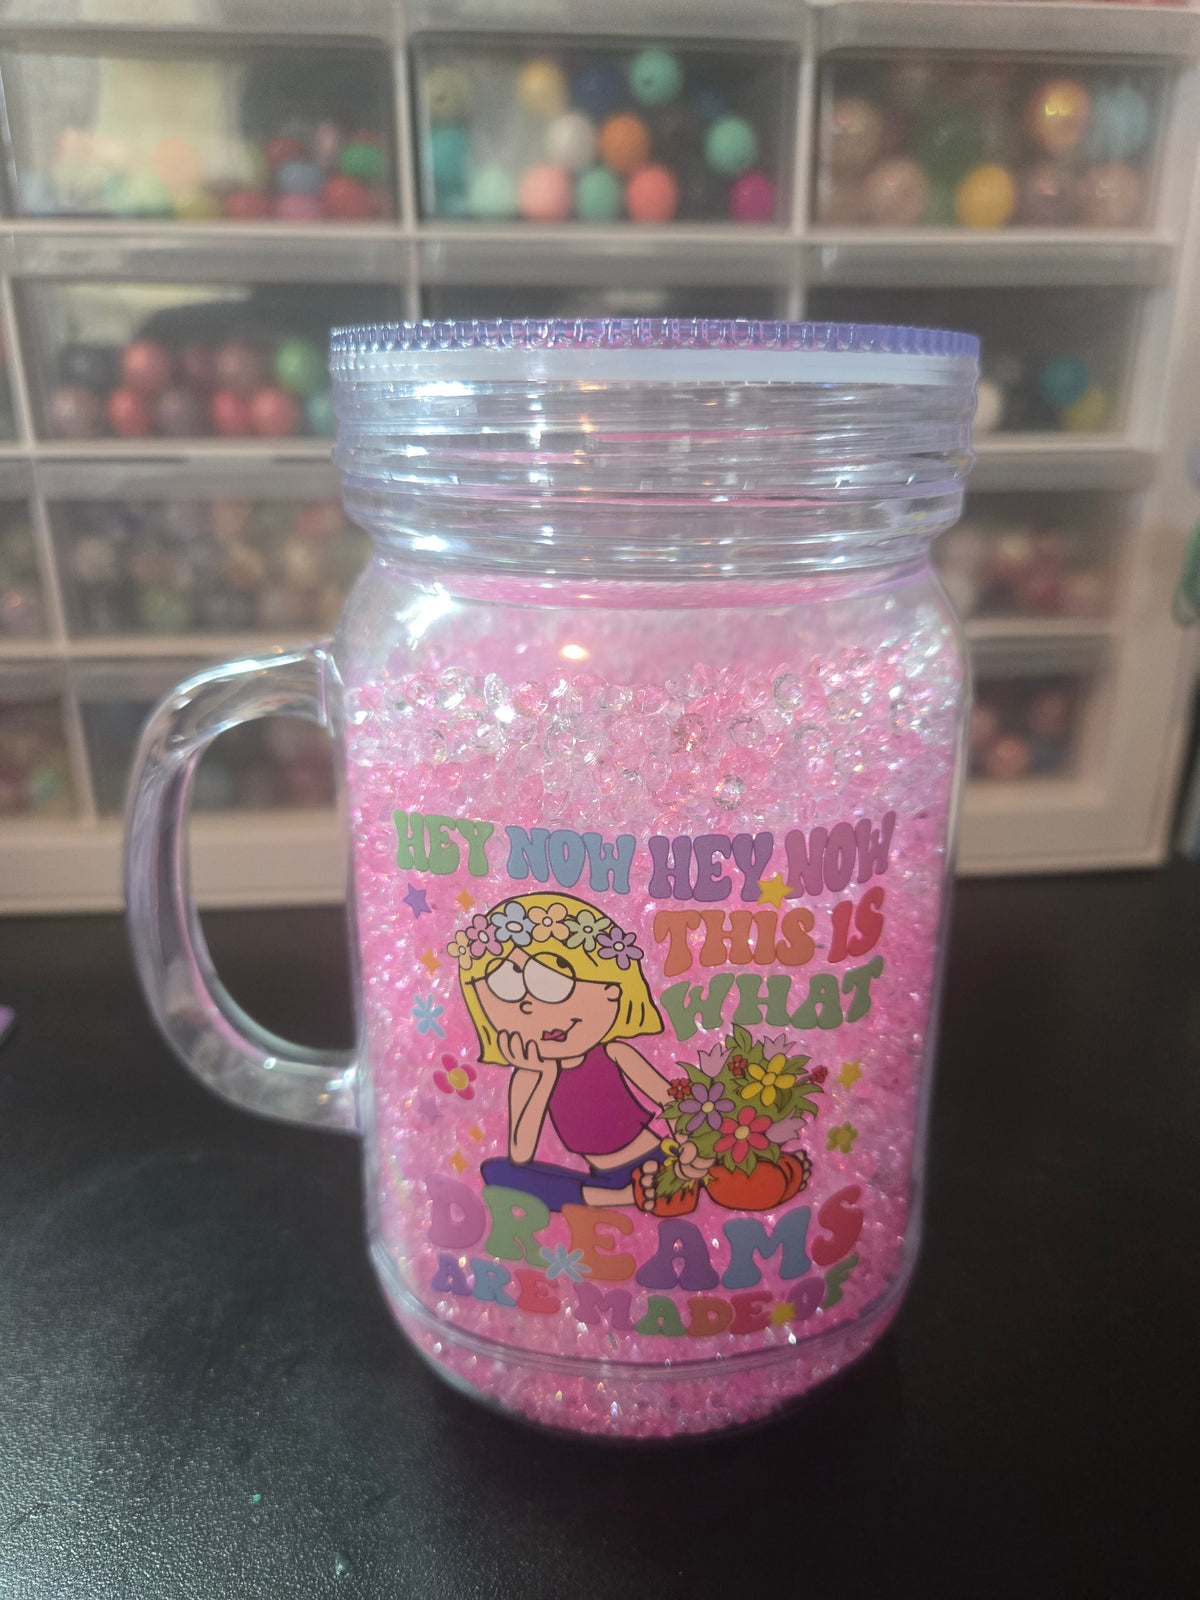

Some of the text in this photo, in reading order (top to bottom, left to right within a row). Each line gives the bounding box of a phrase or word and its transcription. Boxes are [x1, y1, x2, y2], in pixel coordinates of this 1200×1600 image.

[393, 809, 896, 902] HEY NOW HEY NOW
[653, 886, 885, 977] THIS IS
[660, 955, 884, 1042] WHAT
[425, 1173, 864, 1290] DREAMS
[431, 1252, 859, 1337] ARE MADE OF
